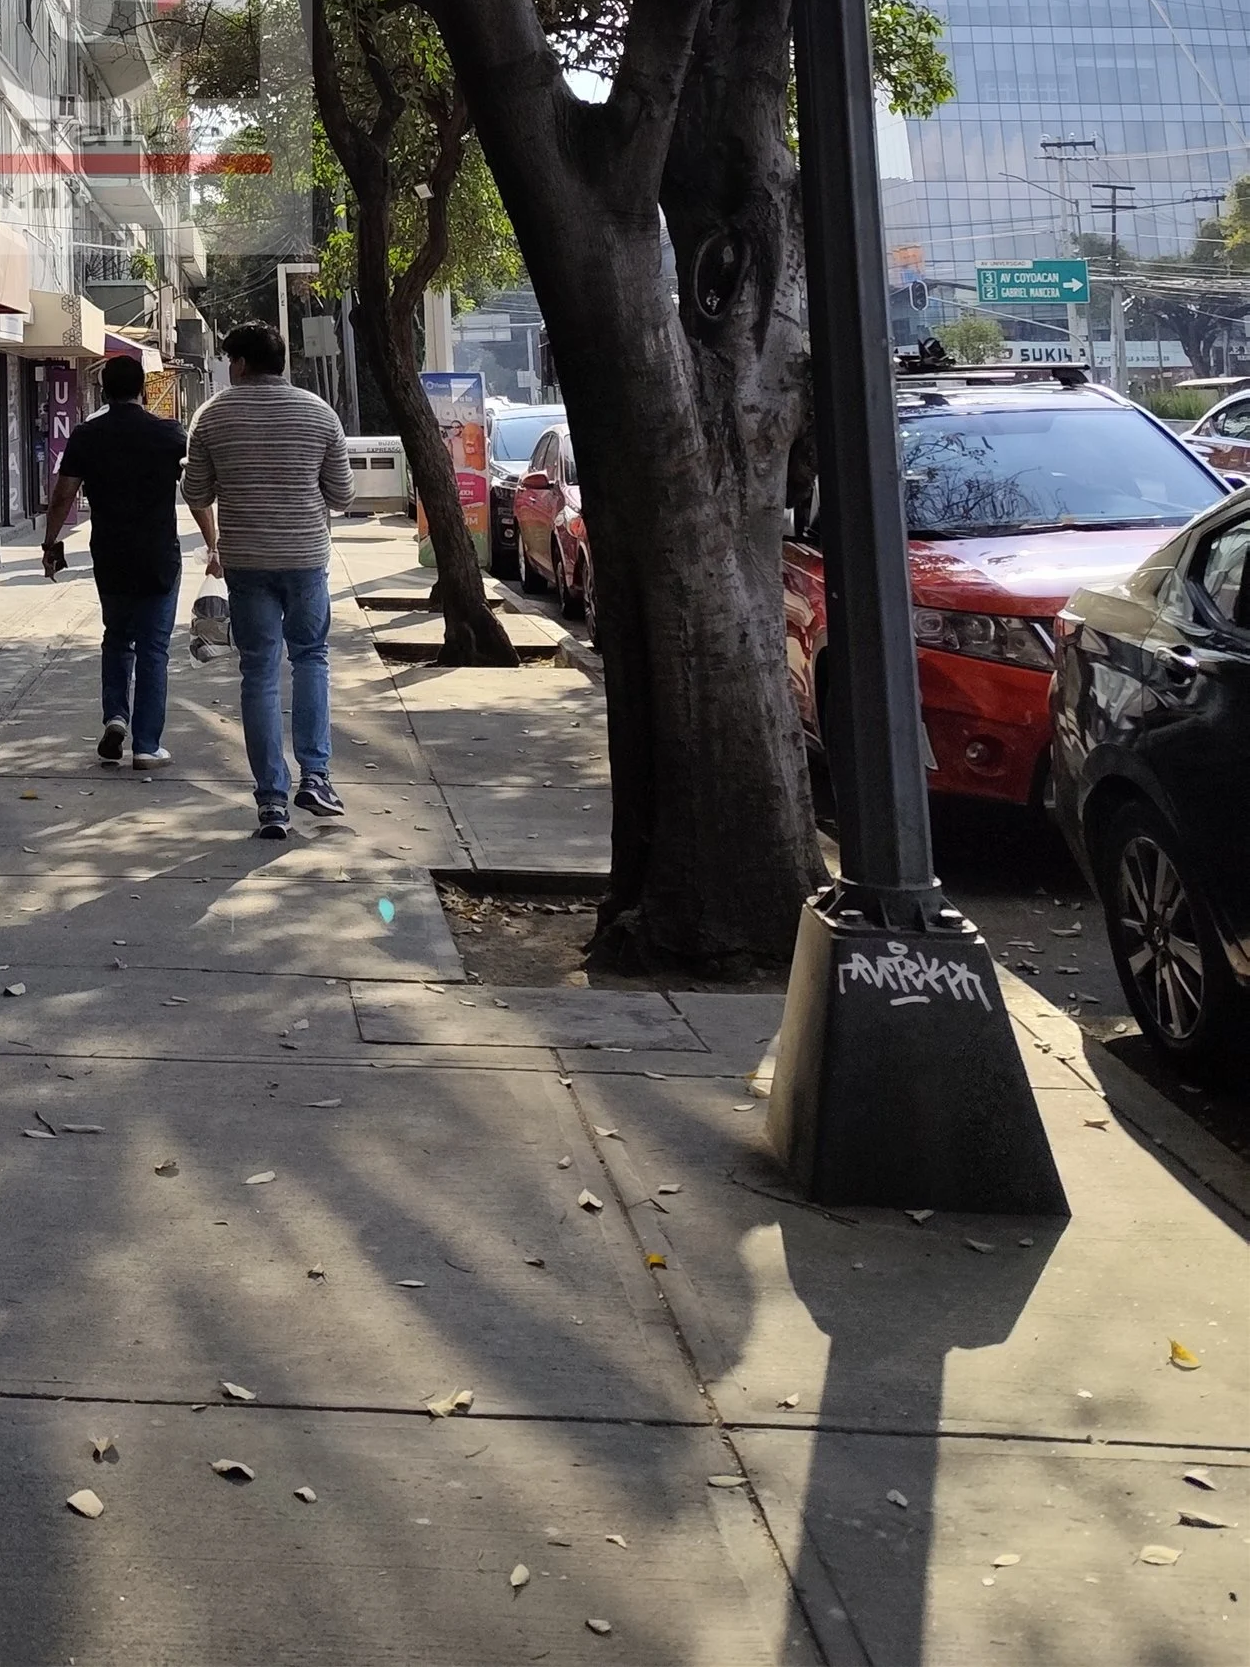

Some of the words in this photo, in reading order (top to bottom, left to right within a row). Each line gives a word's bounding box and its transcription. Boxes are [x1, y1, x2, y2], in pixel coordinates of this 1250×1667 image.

[985, 275, 993, 284] 3
[1000, 273, 1012, 283] AV
[1014, 273, 1060, 283] COYOACAN
[986, 288, 994, 298] 2
[1001, 288, 1028, 298] GABRIEL
[1030, 287, 1061, 298] MANCERA
